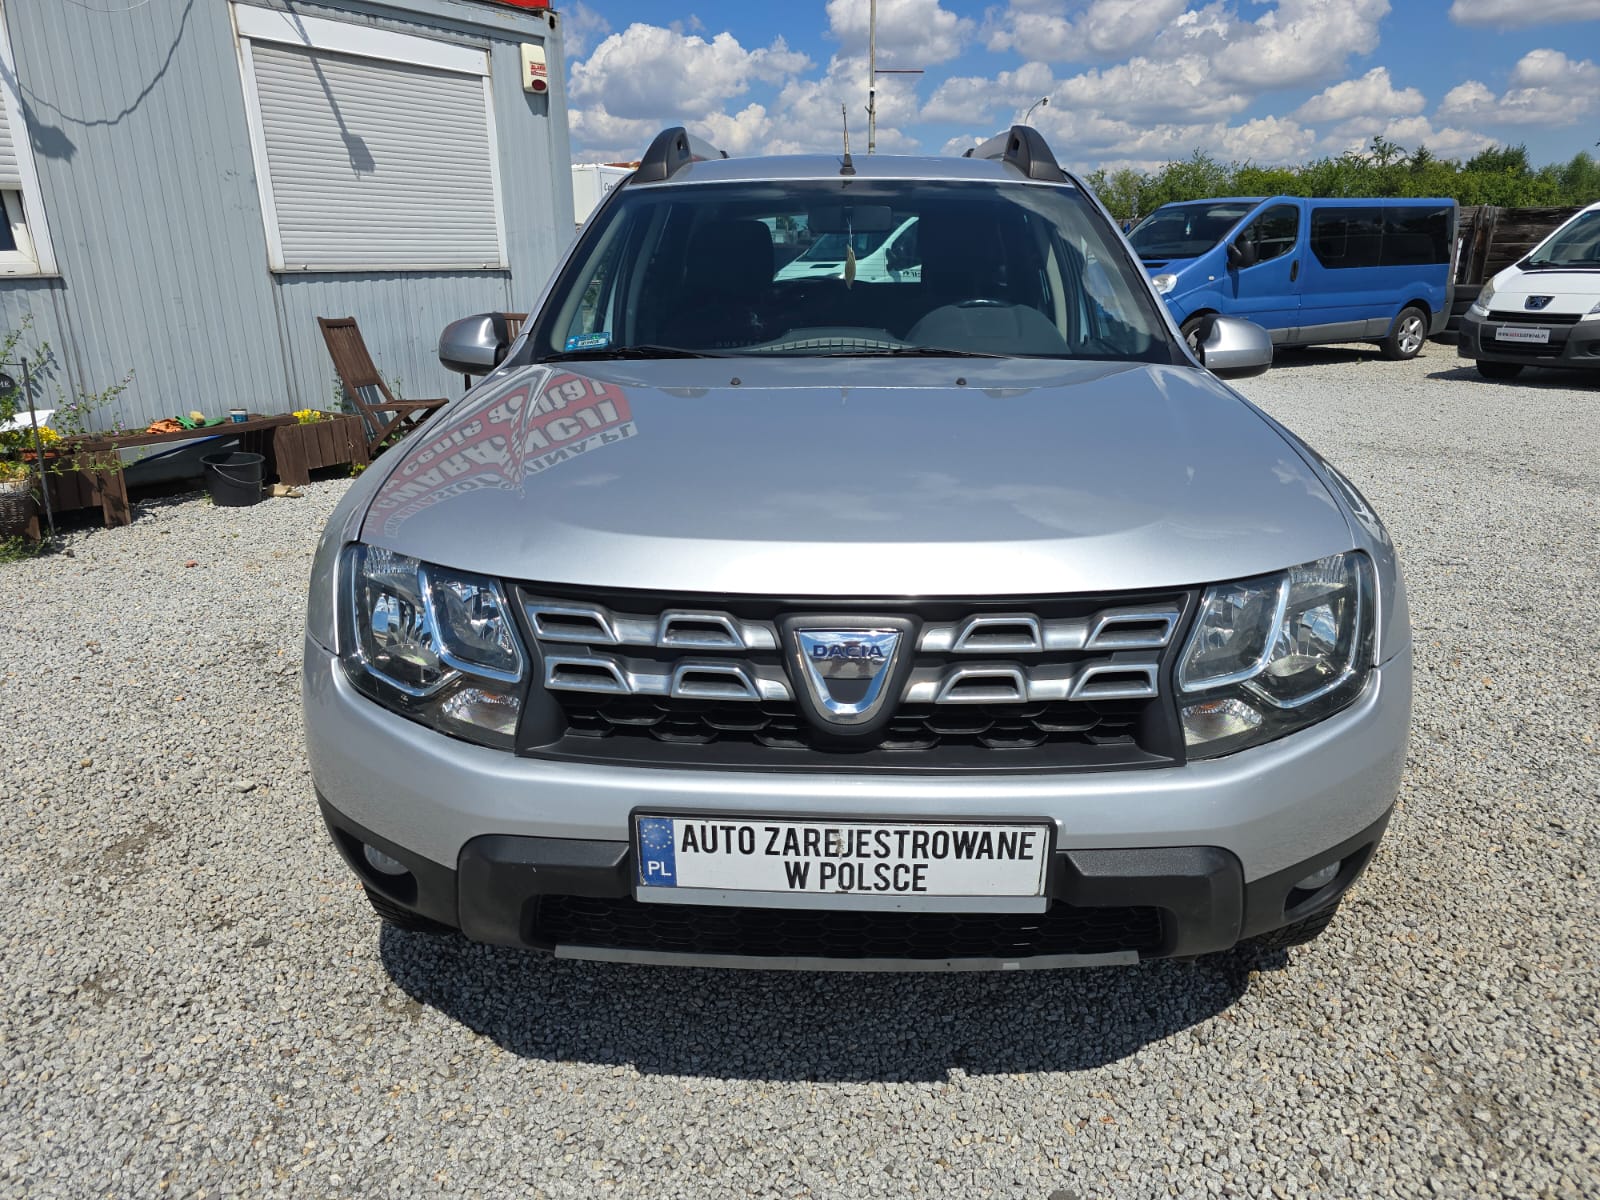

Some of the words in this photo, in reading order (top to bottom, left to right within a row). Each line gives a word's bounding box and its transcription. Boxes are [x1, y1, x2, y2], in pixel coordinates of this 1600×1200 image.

[812, 644, 884, 658] DACIA
[681, 824, 756, 855] AUTO
[764, 826, 1037, 861] ZAREJESTROWANE
[647, 860, 673, 877] PL
[784, 861, 811, 890] W
[819, 861, 929, 892] POLSCE
